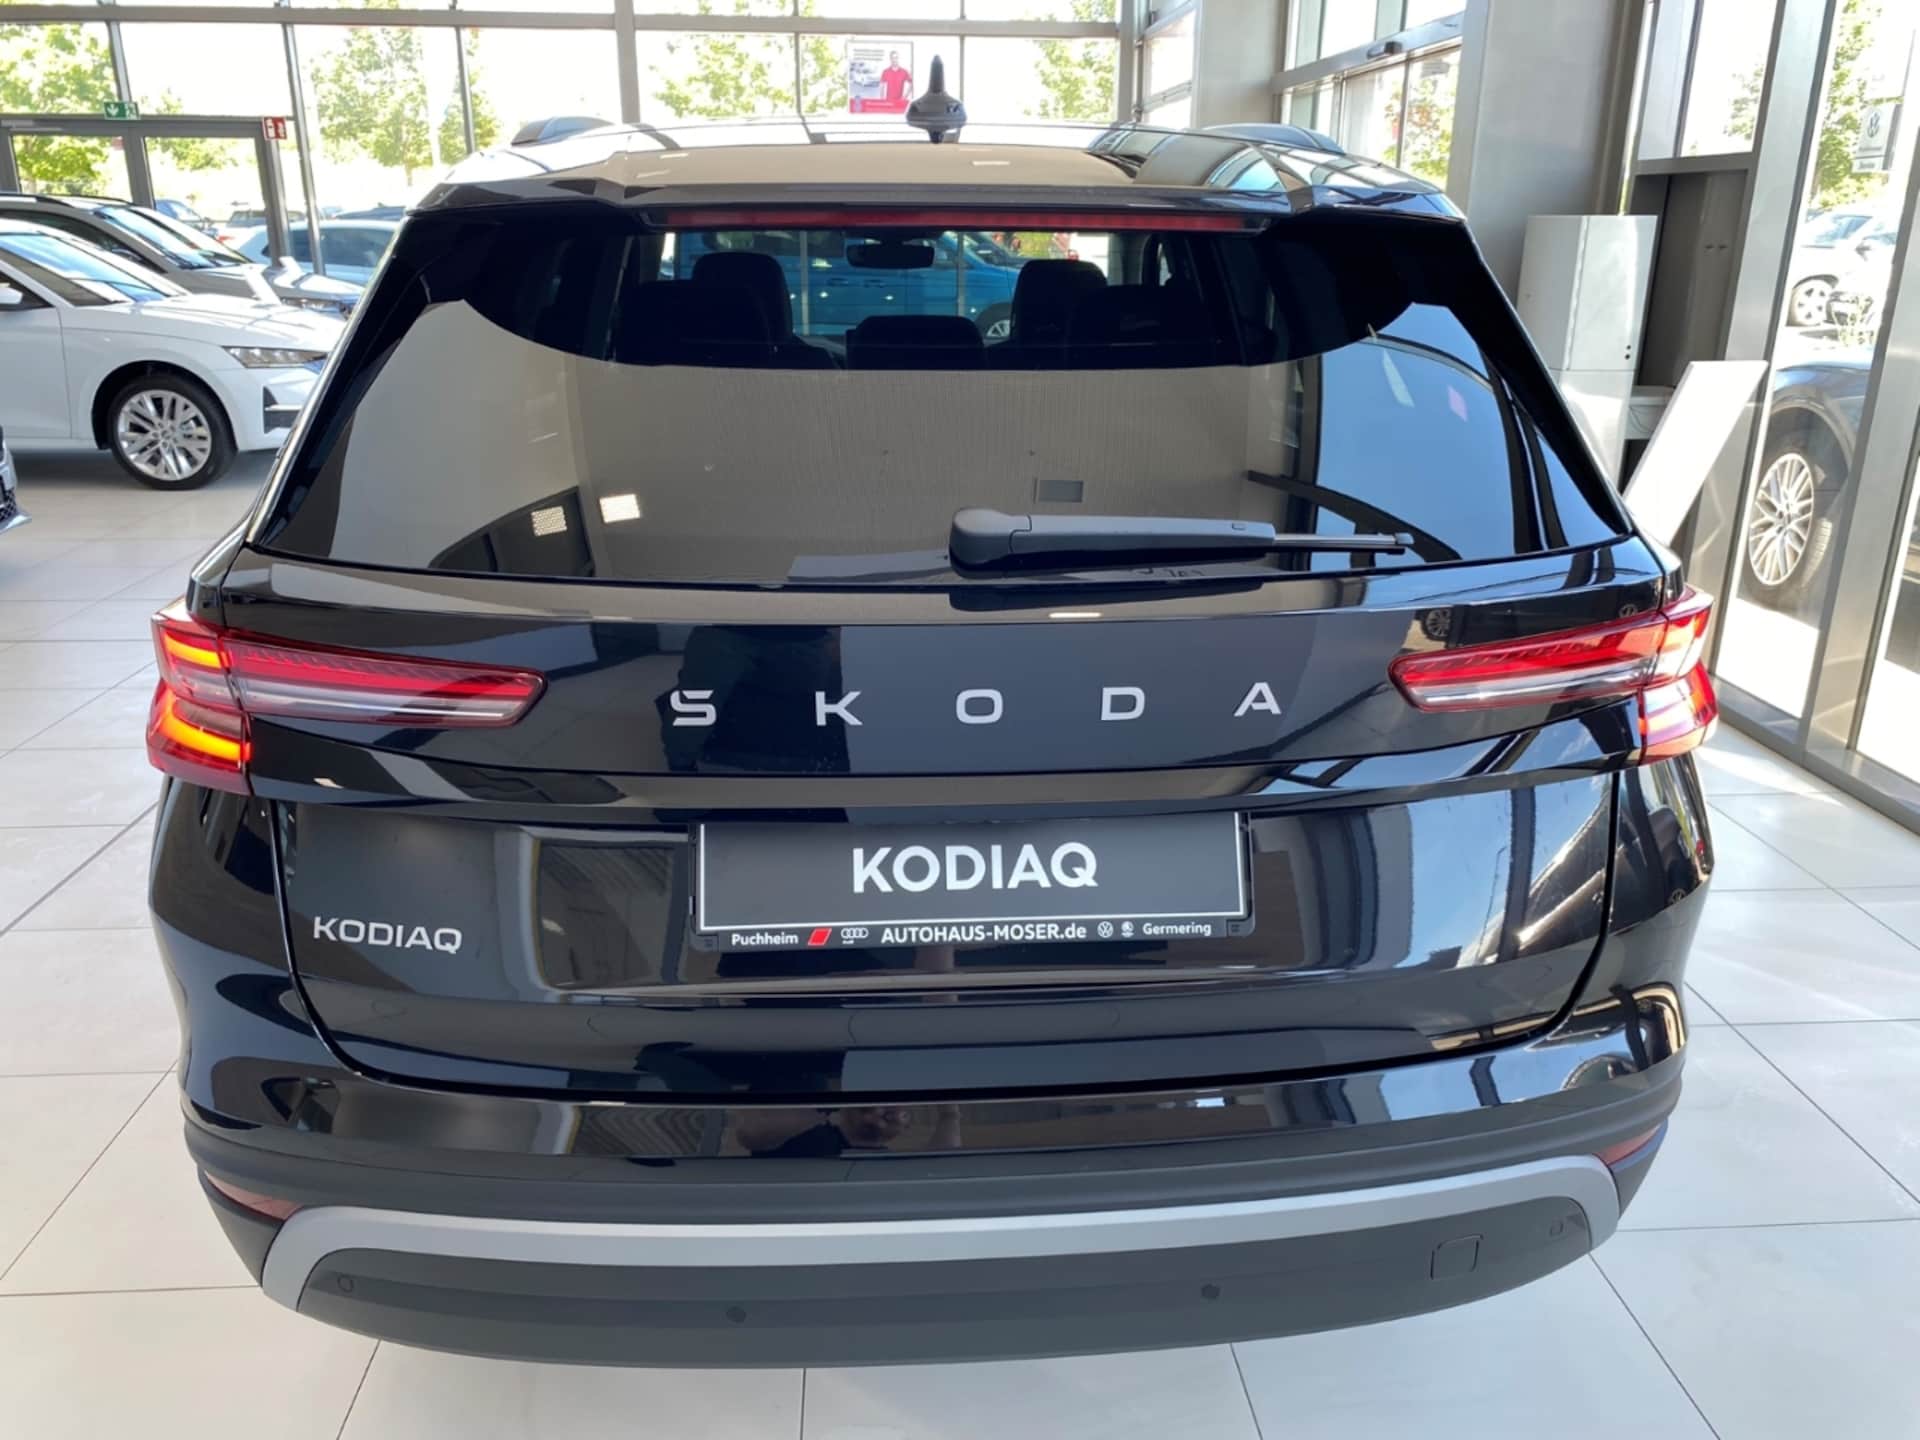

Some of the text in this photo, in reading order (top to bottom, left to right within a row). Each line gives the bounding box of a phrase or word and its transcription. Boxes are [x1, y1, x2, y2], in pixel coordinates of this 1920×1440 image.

[853, 842, 1098, 893] KODIAQ
[313, 916, 463, 954] KODIAQ
[731, 932, 799, 946] Puchheim
[881, 923, 1087, 944] AUTOHAUS-MOSER.de
[1142, 921, 1212, 937] Germering
